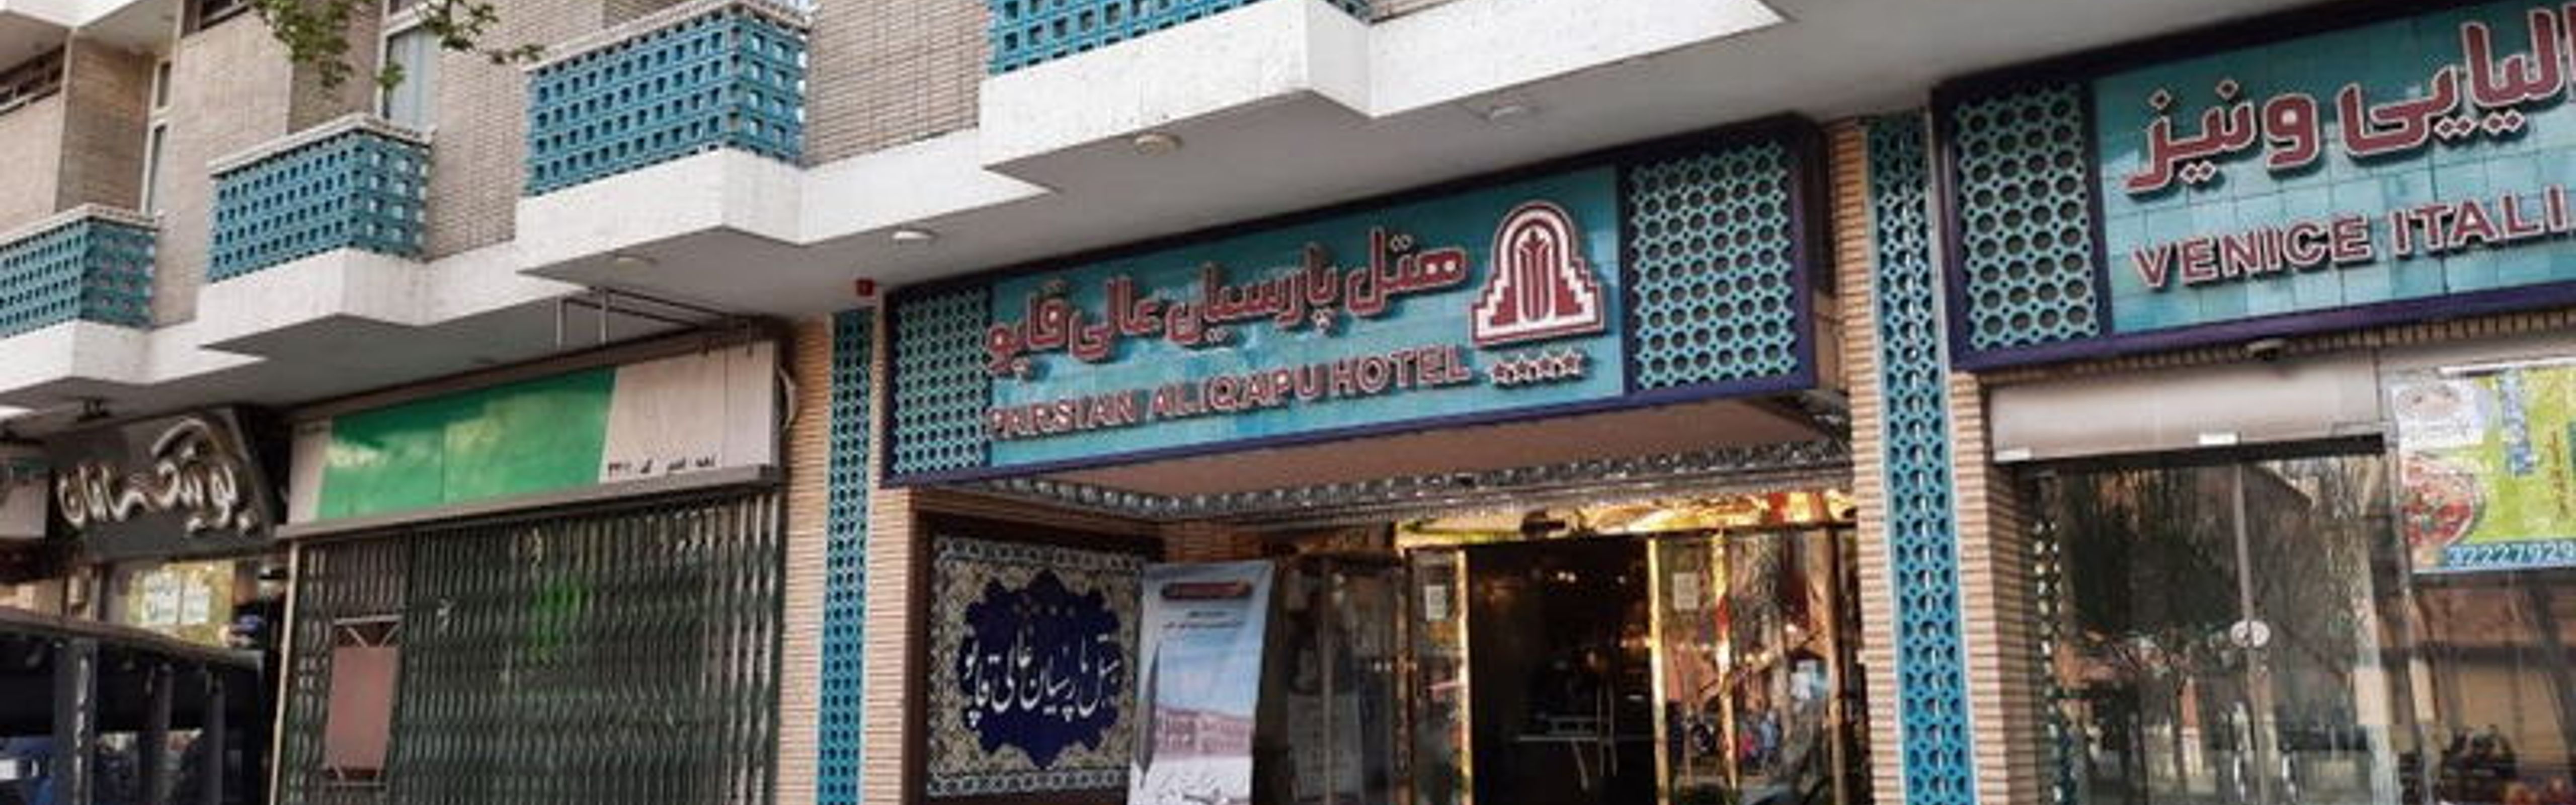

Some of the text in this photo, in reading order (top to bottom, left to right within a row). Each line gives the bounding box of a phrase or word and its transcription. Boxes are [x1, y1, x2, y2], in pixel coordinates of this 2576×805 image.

[2124, 77, 2322, 195] ونیز
[2131, 183, 2567, 290] VENICE ITALI
[984, 226, 1467, 381] هتل پارسیان عالی قاپو
[987, 387, 1137, 438] PARSIAN
[1328, 343, 1472, 395] HOTEL
[151, 418, 258, 536] بوتیک
